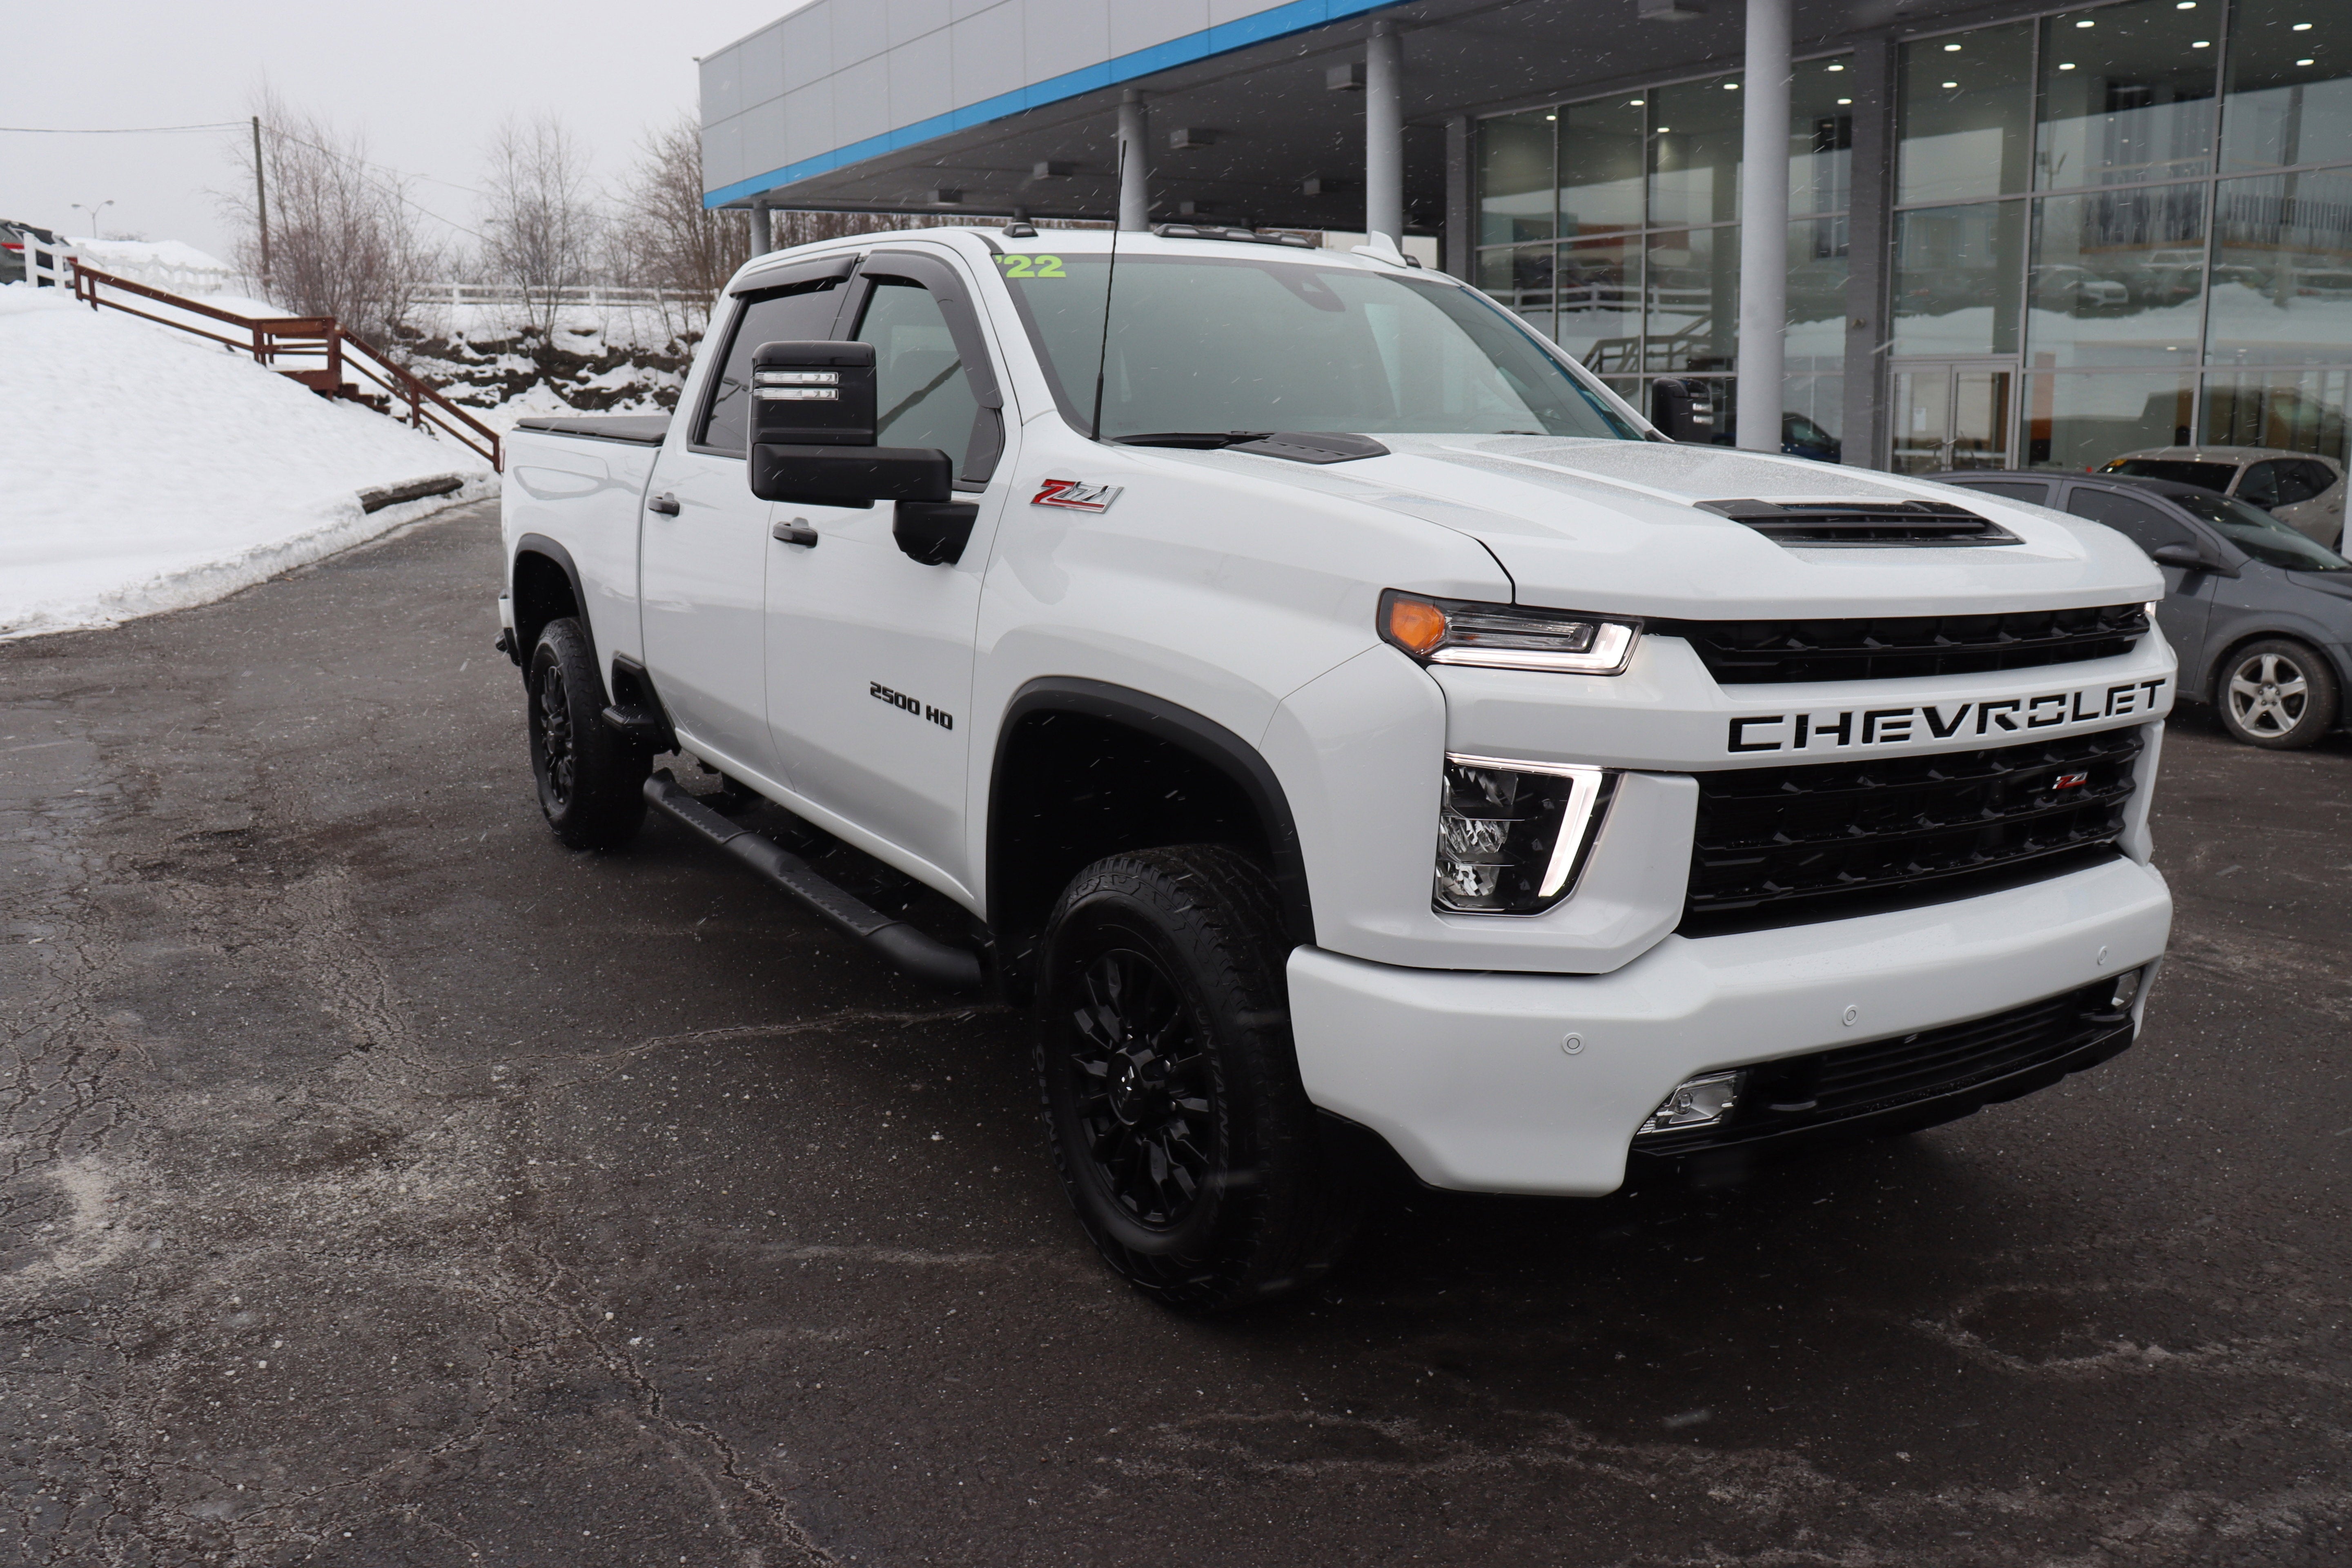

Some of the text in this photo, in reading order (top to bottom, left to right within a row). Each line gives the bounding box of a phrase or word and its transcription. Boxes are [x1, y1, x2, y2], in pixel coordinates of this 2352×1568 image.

[1030, 479, 1124, 514] Z71
[870, 681, 952, 730] 2500 HD
[1728, 679, 2166, 753] CHEVROLET
